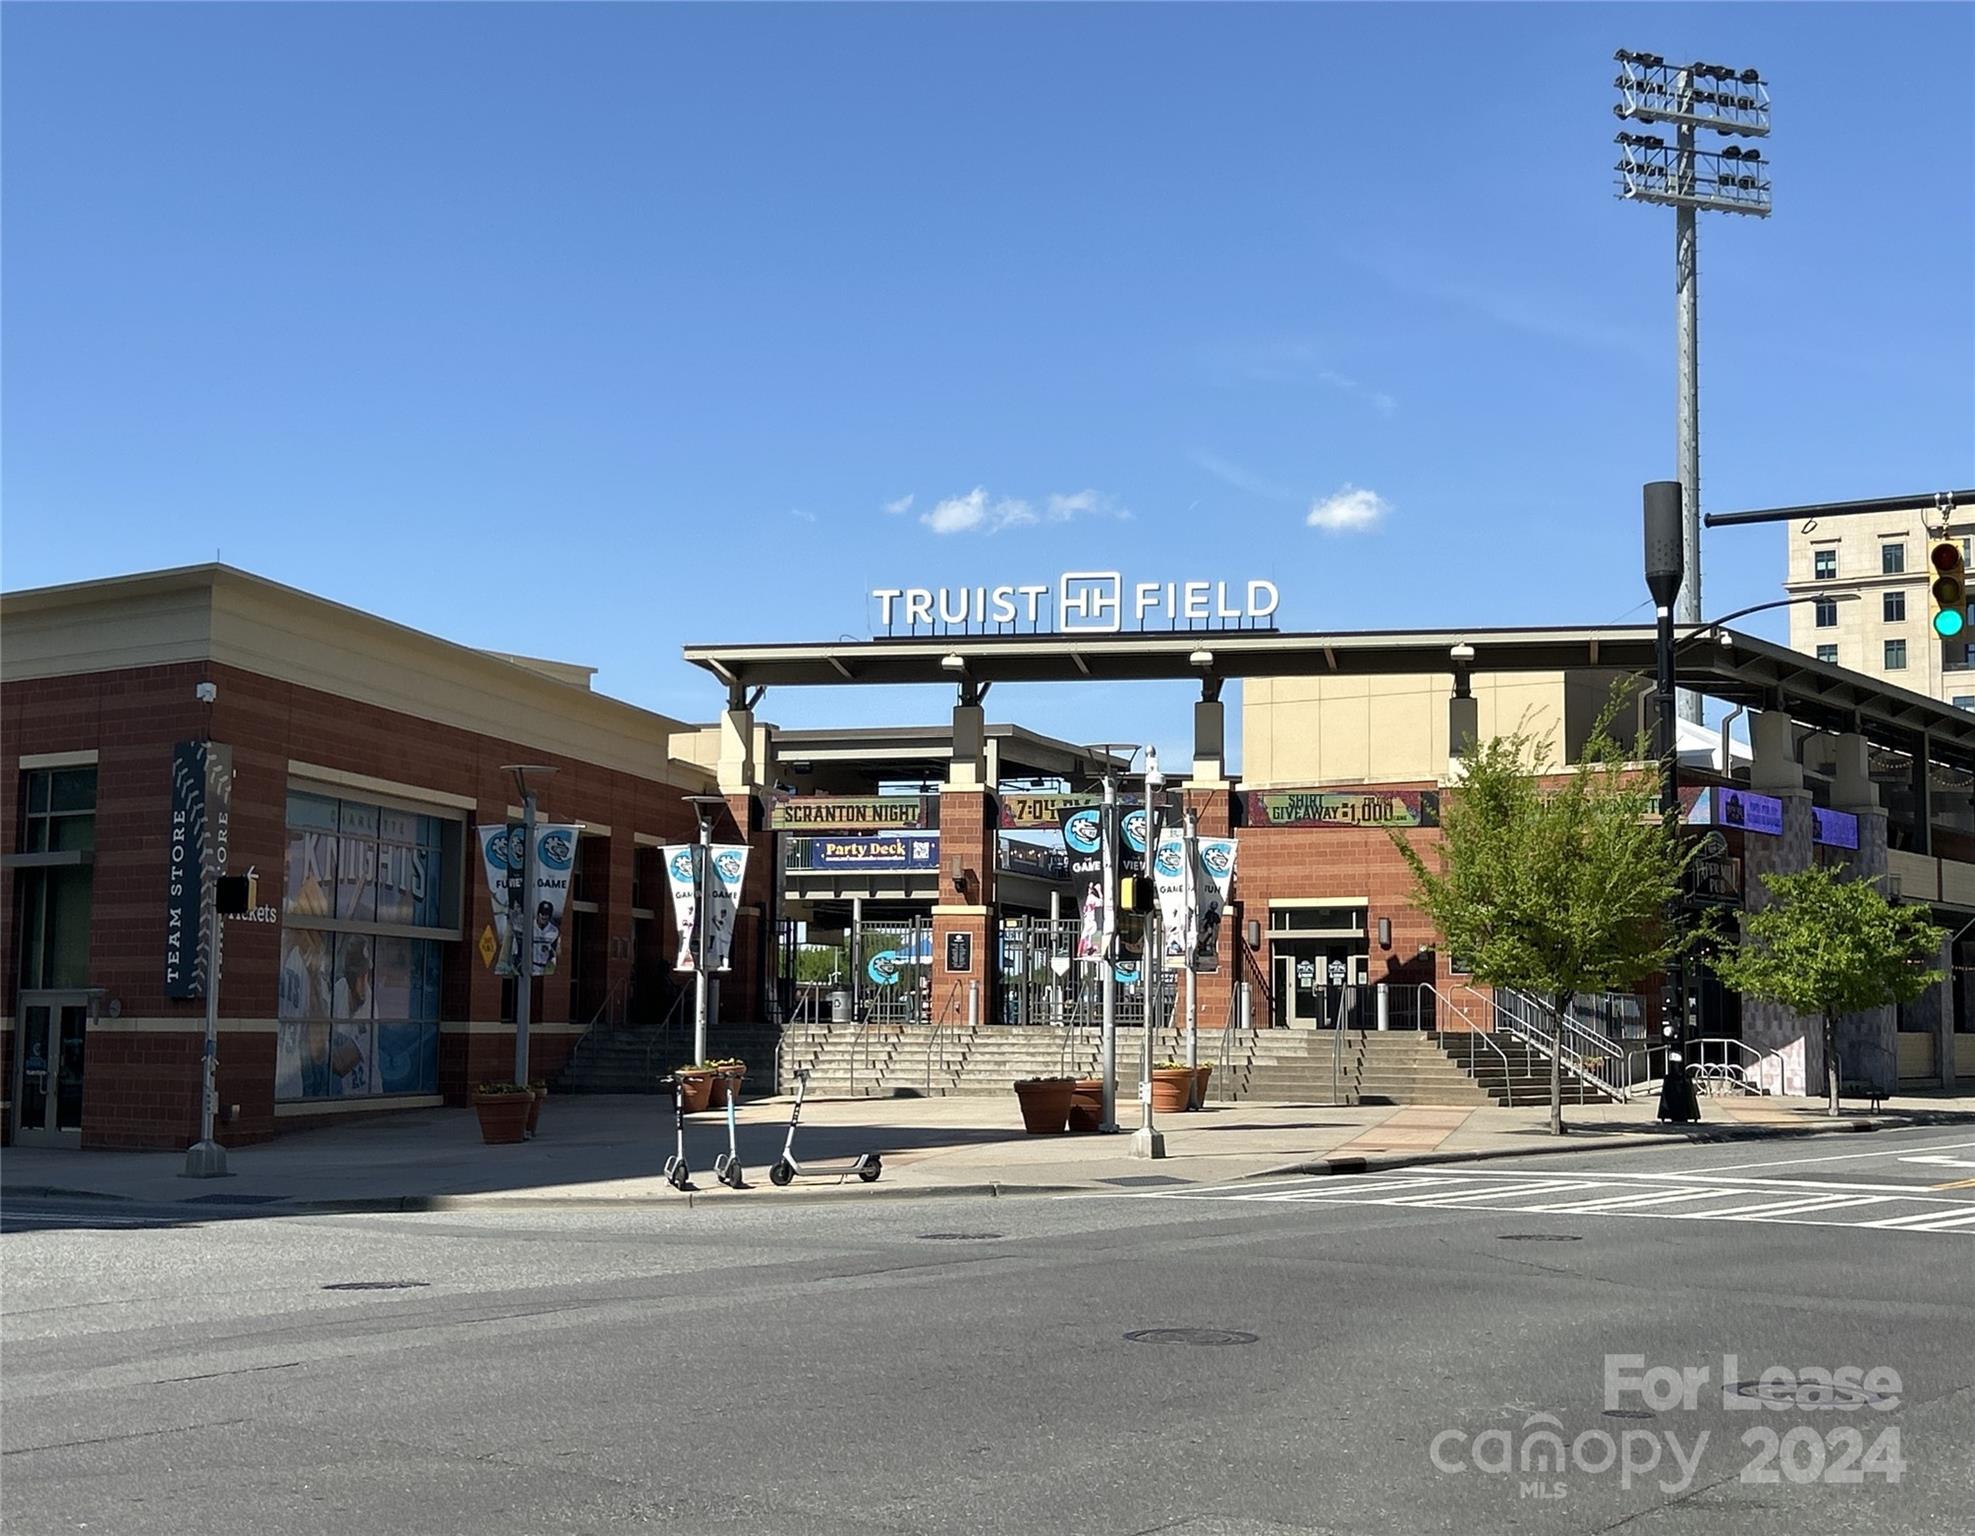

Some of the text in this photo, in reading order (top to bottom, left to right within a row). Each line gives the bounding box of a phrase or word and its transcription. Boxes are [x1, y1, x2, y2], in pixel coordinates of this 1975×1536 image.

[872, 579, 1280, 624] TRUIST FIELD
[1288, 794, 1325, 807] SHIRT
[785, 804, 919, 822] SCRANTON NIGHT
[1017, 799, 1056, 820] 7:04
[1272, 806, 1340, 820] GIVEAWAY
[217, 812, 229, 876] ORE
[826, 841, 905, 857] Party Deck
[496, 879, 508, 889] FU
[537, 878, 567, 889] GAME
[167, 810, 186, 983] TEAM STORE
